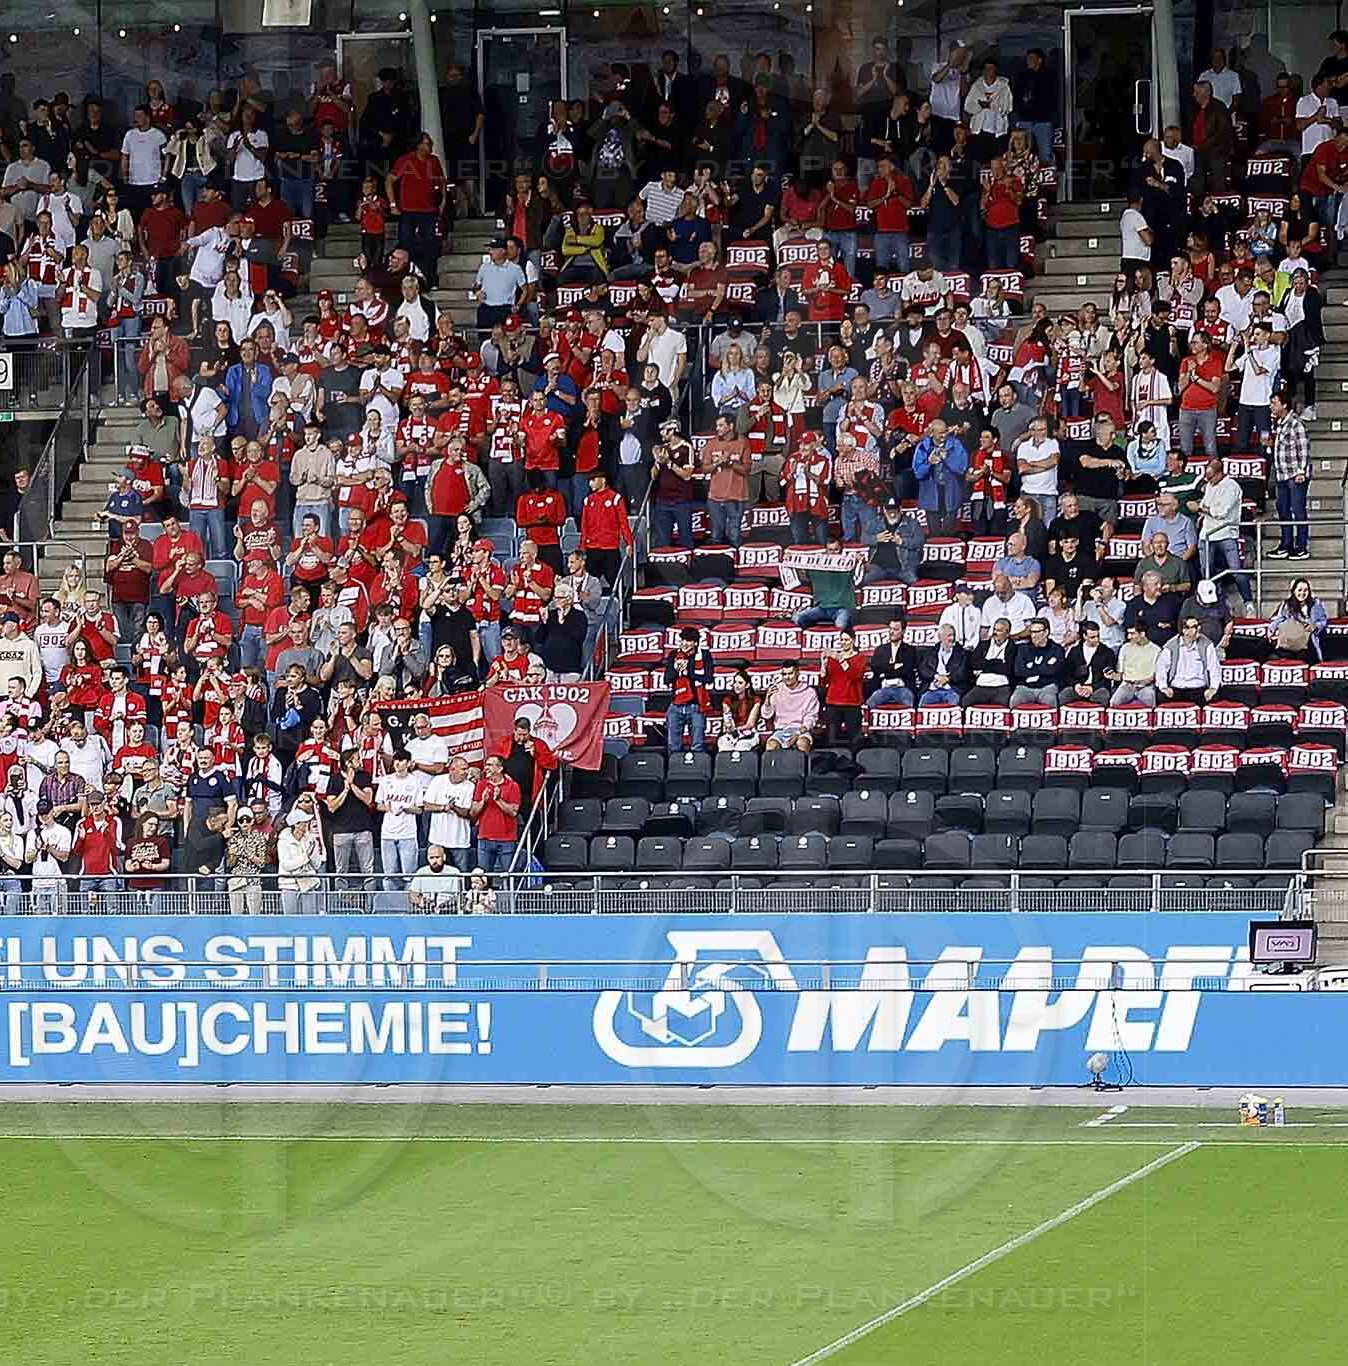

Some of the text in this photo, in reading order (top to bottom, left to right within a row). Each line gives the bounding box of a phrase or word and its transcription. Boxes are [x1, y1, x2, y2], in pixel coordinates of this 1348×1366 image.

[1248, 160, 1283, 176] 1902
[729, 249, 767, 264] 1902
[1225, 462, 1261, 476] 1902
[680, 590, 719, 607] 1902
[725, 590, 764, 607] 1902
[863, 587, 903, 603] 1902
[909, 586, 949, 603] 1902
[620, 636, 659, 654] 1902
[712, 631, 751, 648] 1902
[759, 630, 798, 646] 1902
[1264, 668, 1303, 684] 1902
[503, 686, 590, 705] GAK 1902
[872, 710, 911, 727] 1902
[923, 709, 961, 726] 1902
[967, 710, 1004, 727] 1902
[1013, 713, 1053, 729] 1902
[1060, 710, 1099, 727] 1902
[1108, 712, 1148, 729] 1902
[1157, 710, 1197, 726] 1902
[1205, 710, 1245, 726] 1902
[1305, 709, 1344, 726] 1902
[1050, 753, 1090, 770] 1902
[1147, 754, 1187, 772] 1902
[1193, 754, 1233, 770] 1902
[1293, 752, 1333, 768] 1902
[43, 936, 184, 988] UNS
[205, 935, 472, 988] STIMMT
[788, 946, 1245, 1052] MAPEI
[9, 1002, 491, 1066] [BAU]CHEMIE!
